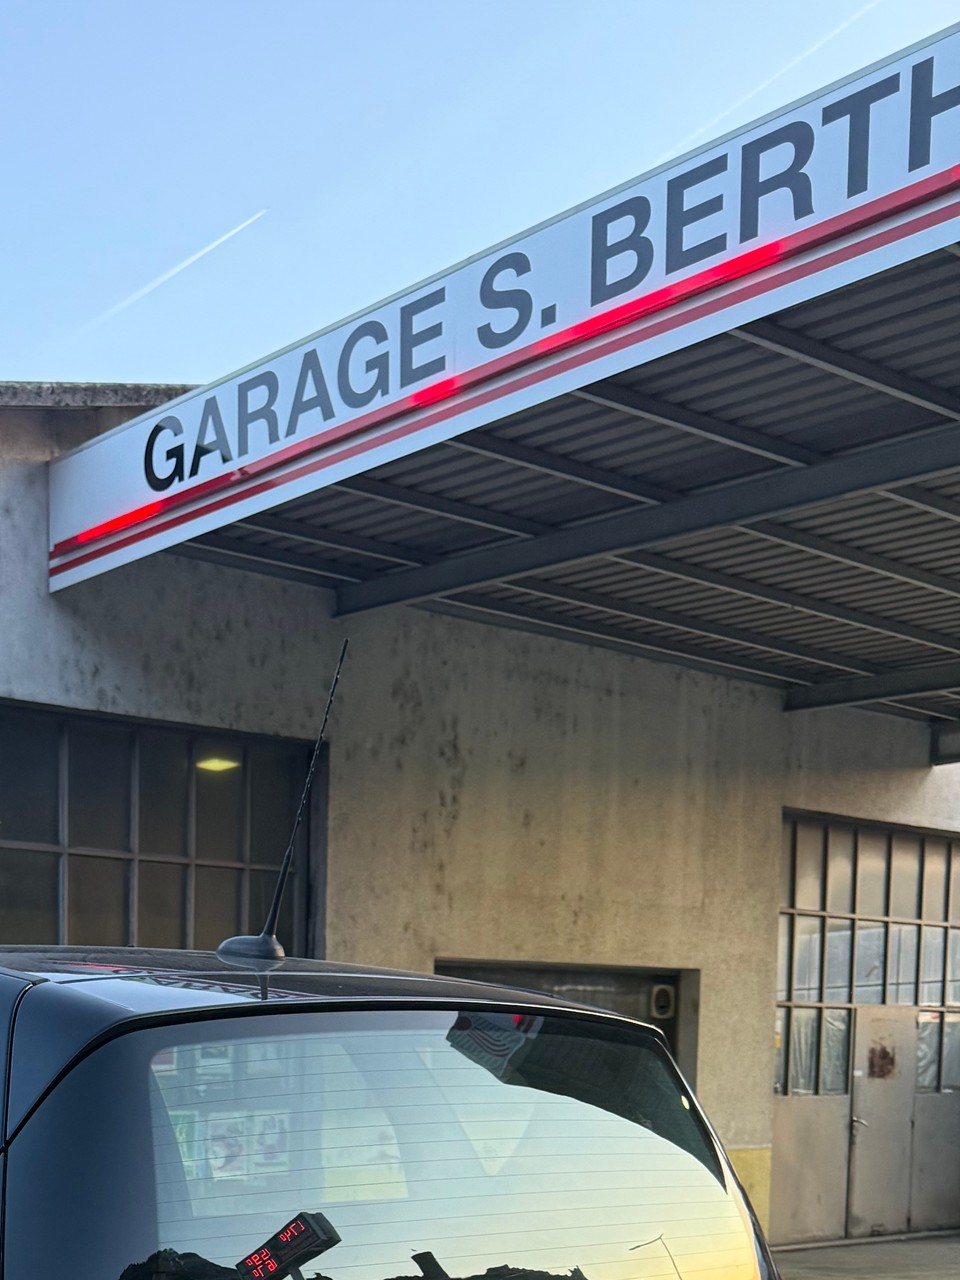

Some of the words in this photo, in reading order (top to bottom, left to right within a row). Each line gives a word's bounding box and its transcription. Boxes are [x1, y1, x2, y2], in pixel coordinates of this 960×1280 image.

[144, 286, 446, 492] GARAGE
[477, 251, 557, 350] S.
[590, 55, 960, 308] BERTH
